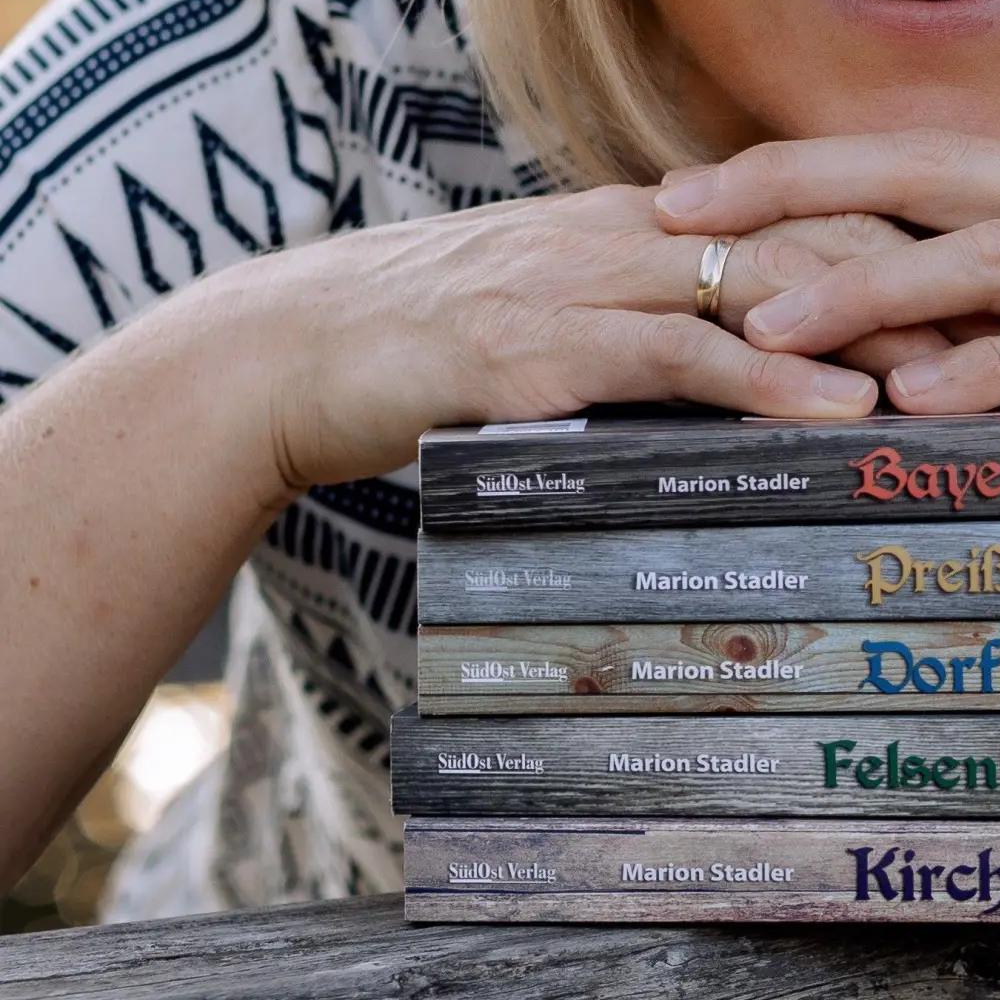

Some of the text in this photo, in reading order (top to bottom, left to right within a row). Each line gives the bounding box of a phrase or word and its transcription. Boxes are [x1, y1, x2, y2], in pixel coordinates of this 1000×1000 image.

[476, 472, 585, 496] SüdOst Verlag
[658, 473, 810, 494] Marion Stadler
[464, 569, 572, 592] SüdOst Verlag
[635, 571, 809, 590] Marion Stadler
[461, 661, 568, 683] SüdOst Verlag
[631, 660, 803, 680] Marion Stadler
[438, 752, 544, 774] SüdOst Verlag
[608, 753, 780, 774] Marion Stadler
[449, 862, 556, 884] SüdOst Verlag
[622, 863, 795, 883] Marion Stadler
